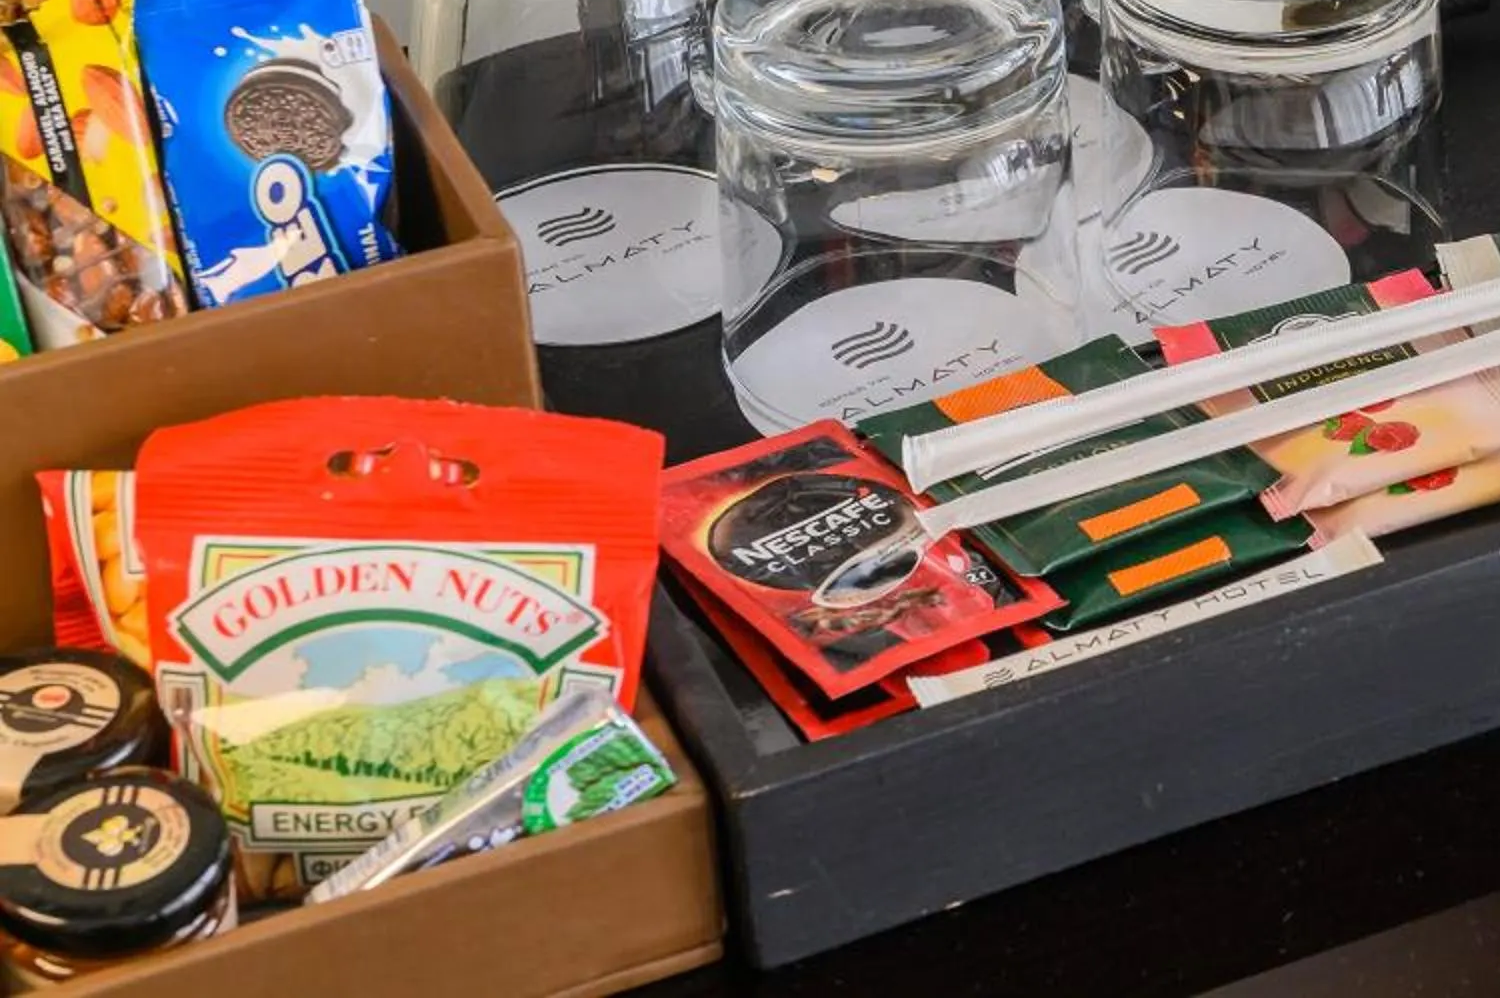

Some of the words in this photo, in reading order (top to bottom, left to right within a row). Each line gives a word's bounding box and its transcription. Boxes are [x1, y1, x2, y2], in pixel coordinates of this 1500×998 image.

[21, 51, 49, 107] ALMOND
[50, 103, 68, 129] SEA
[528, 220, 694, 294] ALMATY
[1135, 237, 1262, 324] ALMATY
[842, 338, 1000, 420] ALMATY
[1275, 351, 1397, 393] INDULGENCE
[767, 512, 892, 574] CLASSIC
[212, 561, 418, 640] GOLDEN
[436, 567, 561, 638] NUTS
[1025, 610, 1171, 673] ALMATY
[1191, 563, 1326, 608] HOTEL
[272, 809, 396, 835] ENERGY
